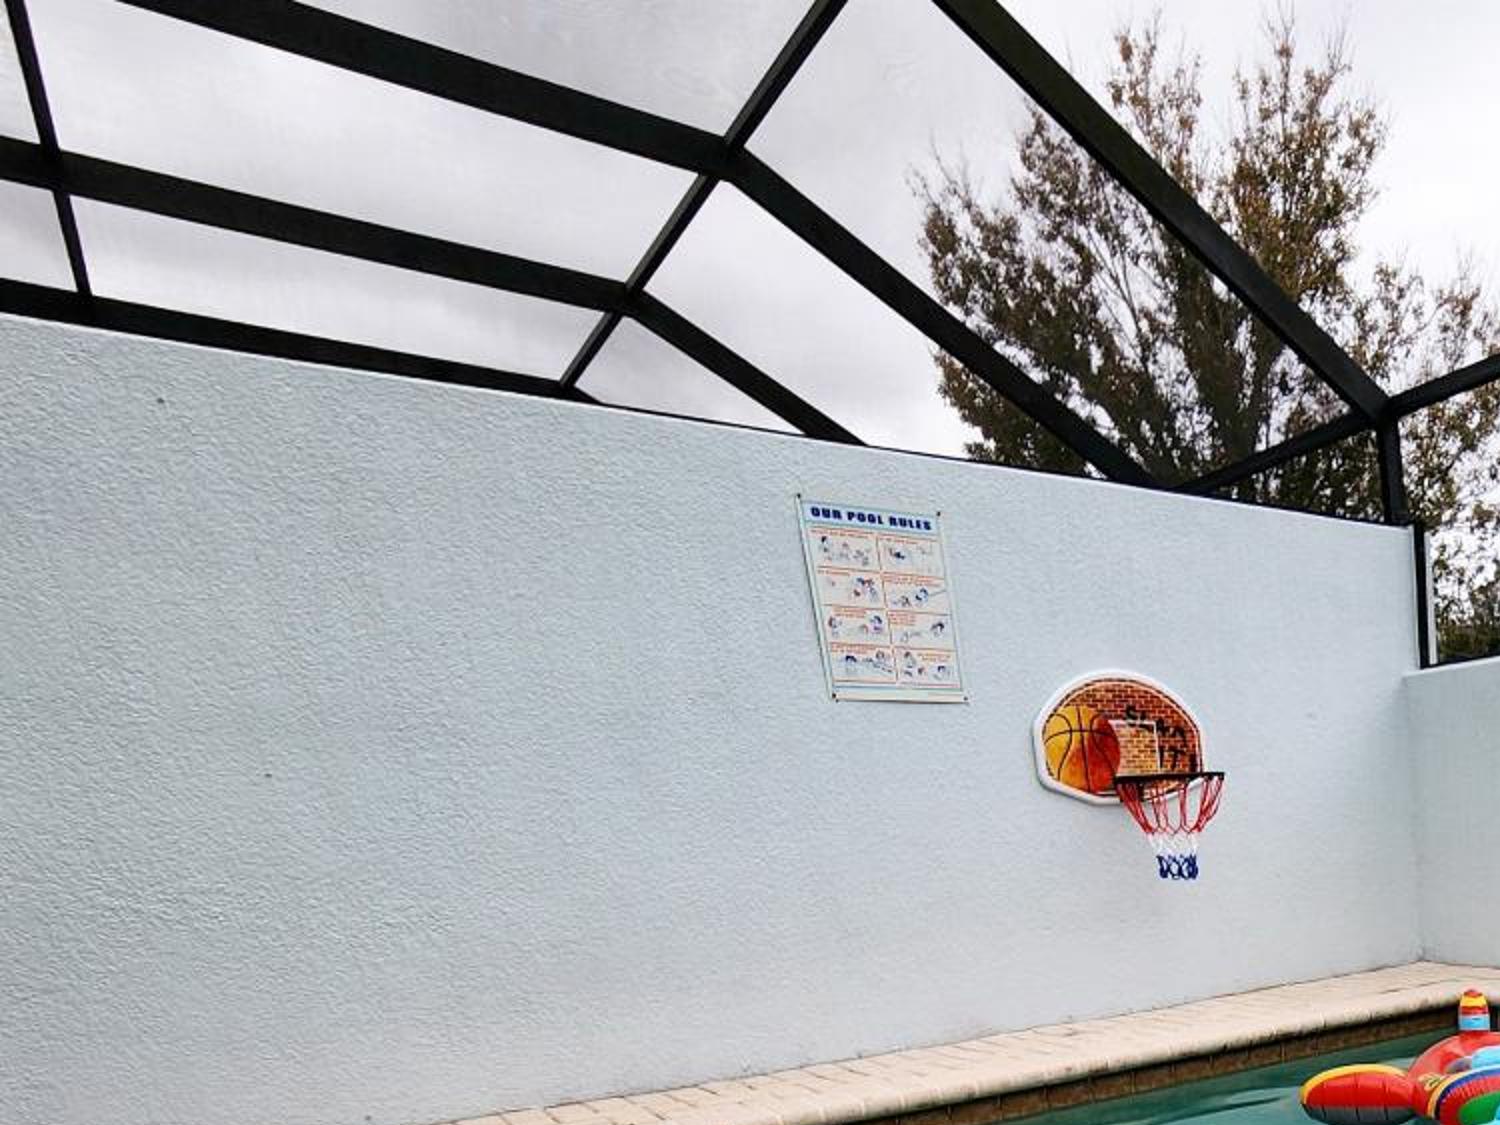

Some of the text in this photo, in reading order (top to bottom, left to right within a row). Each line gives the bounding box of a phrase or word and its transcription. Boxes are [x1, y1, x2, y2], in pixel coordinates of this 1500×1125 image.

[810, 506, 931, 531] OUR POOL RULES
